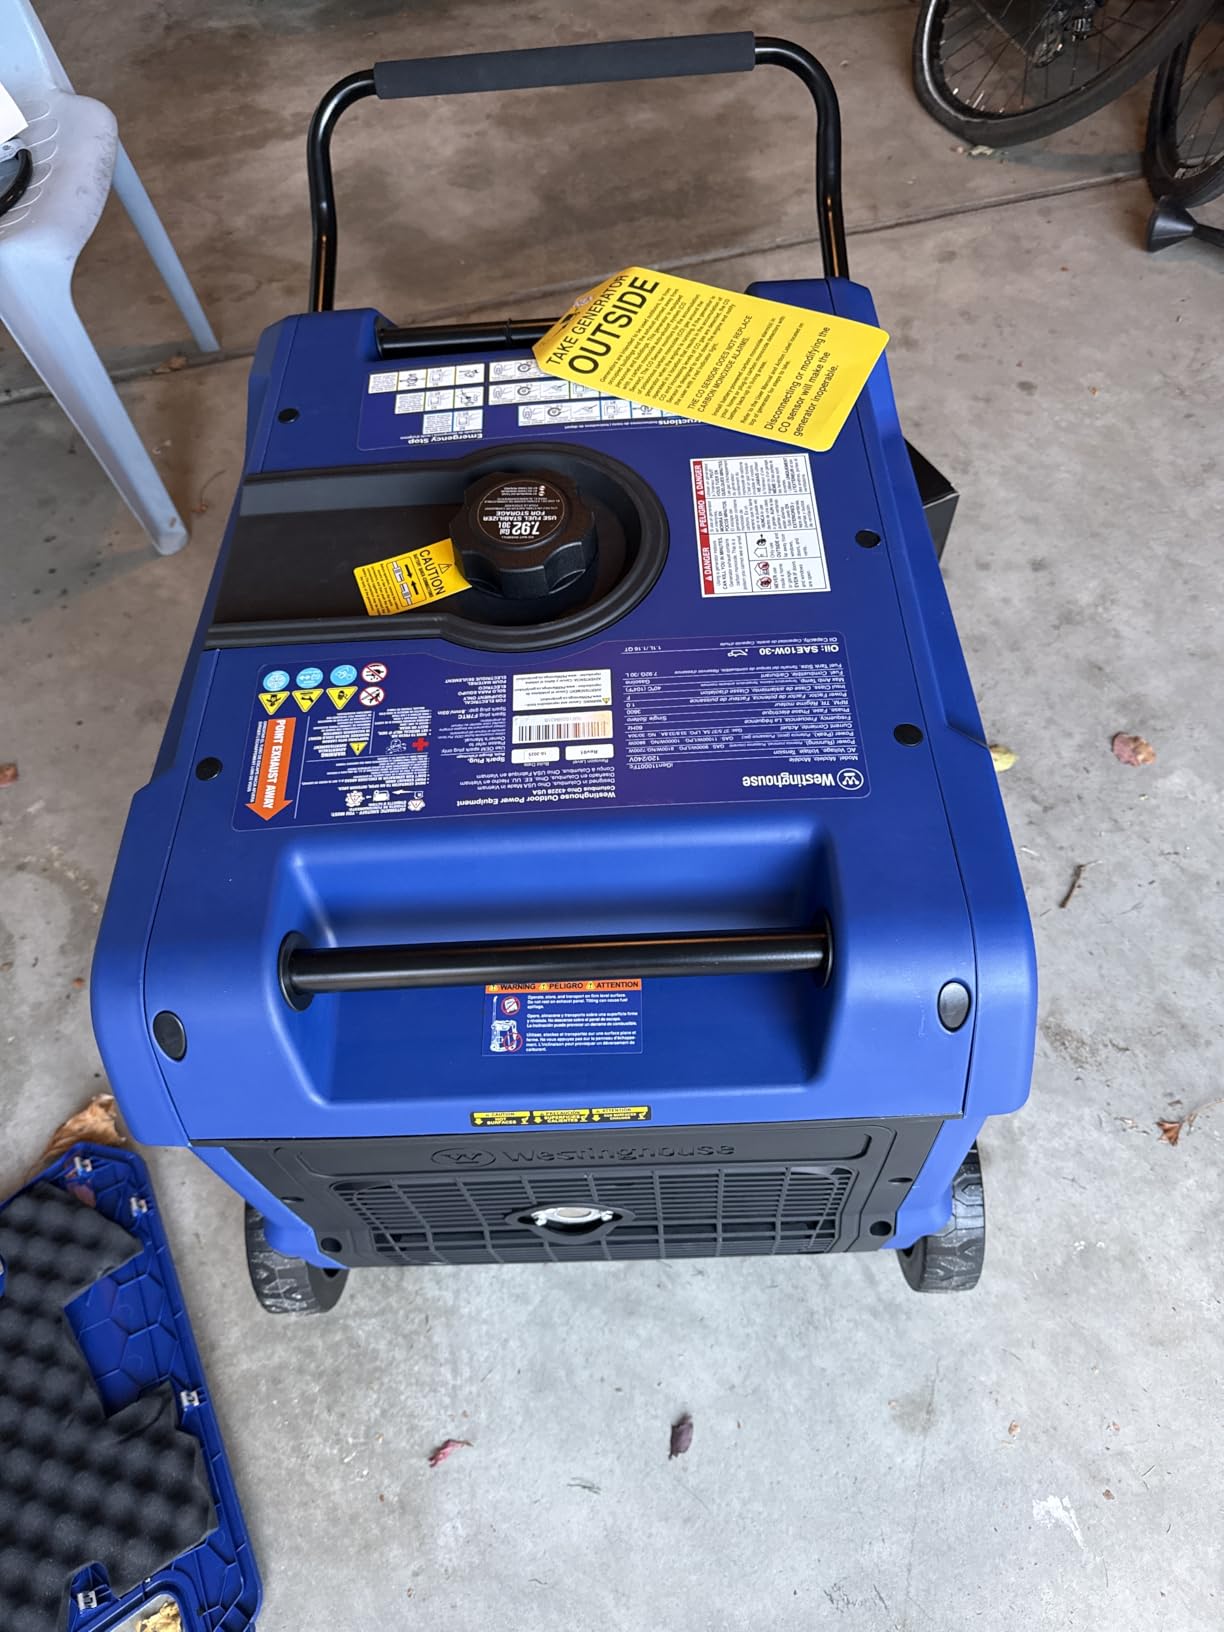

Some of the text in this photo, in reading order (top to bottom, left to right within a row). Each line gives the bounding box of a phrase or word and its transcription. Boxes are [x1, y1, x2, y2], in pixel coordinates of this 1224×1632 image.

[545, 275, 629, 366] TAKE GENERATOR
[567, 275, 660, 376] OUTSIDE
[686, 314, 753, 409] THE CO SENSOR DOES NOT REPLACE
[696, 388, 717, 412] CARBON
[712, 359, 735, 389] MONOXIDE
[763, 326, 830, 431] Disconnecting or modifying the
[777, 351, 830, 433] CO sensor will make the
[791, 362, 839, 437] generator inoperable.
[407, 432, 483, 445] Emergency Stop
[694, 464, 703, 489] DANGER
[698, 499, 706, 527] PELIGRO
[512, 522, 540, 535] 7.92
[419, 549, 446, 595] CAUTION
[702, 546, 711, 574] DANGER
[758, 644, 839, 655] Oil: SAE10W-30
[263, 719, 286, 808] POINT EXHAUST AWAY
[486, 755, 505, 763] Spark
[587, 776, 615, 784] Designed
[742, 772, 835, 787] Westinghouse
[456, 790, 615, 806] Westinghouse Outdoor Power Equipment
[502, 1142, 735, 1162] Westinghouse
